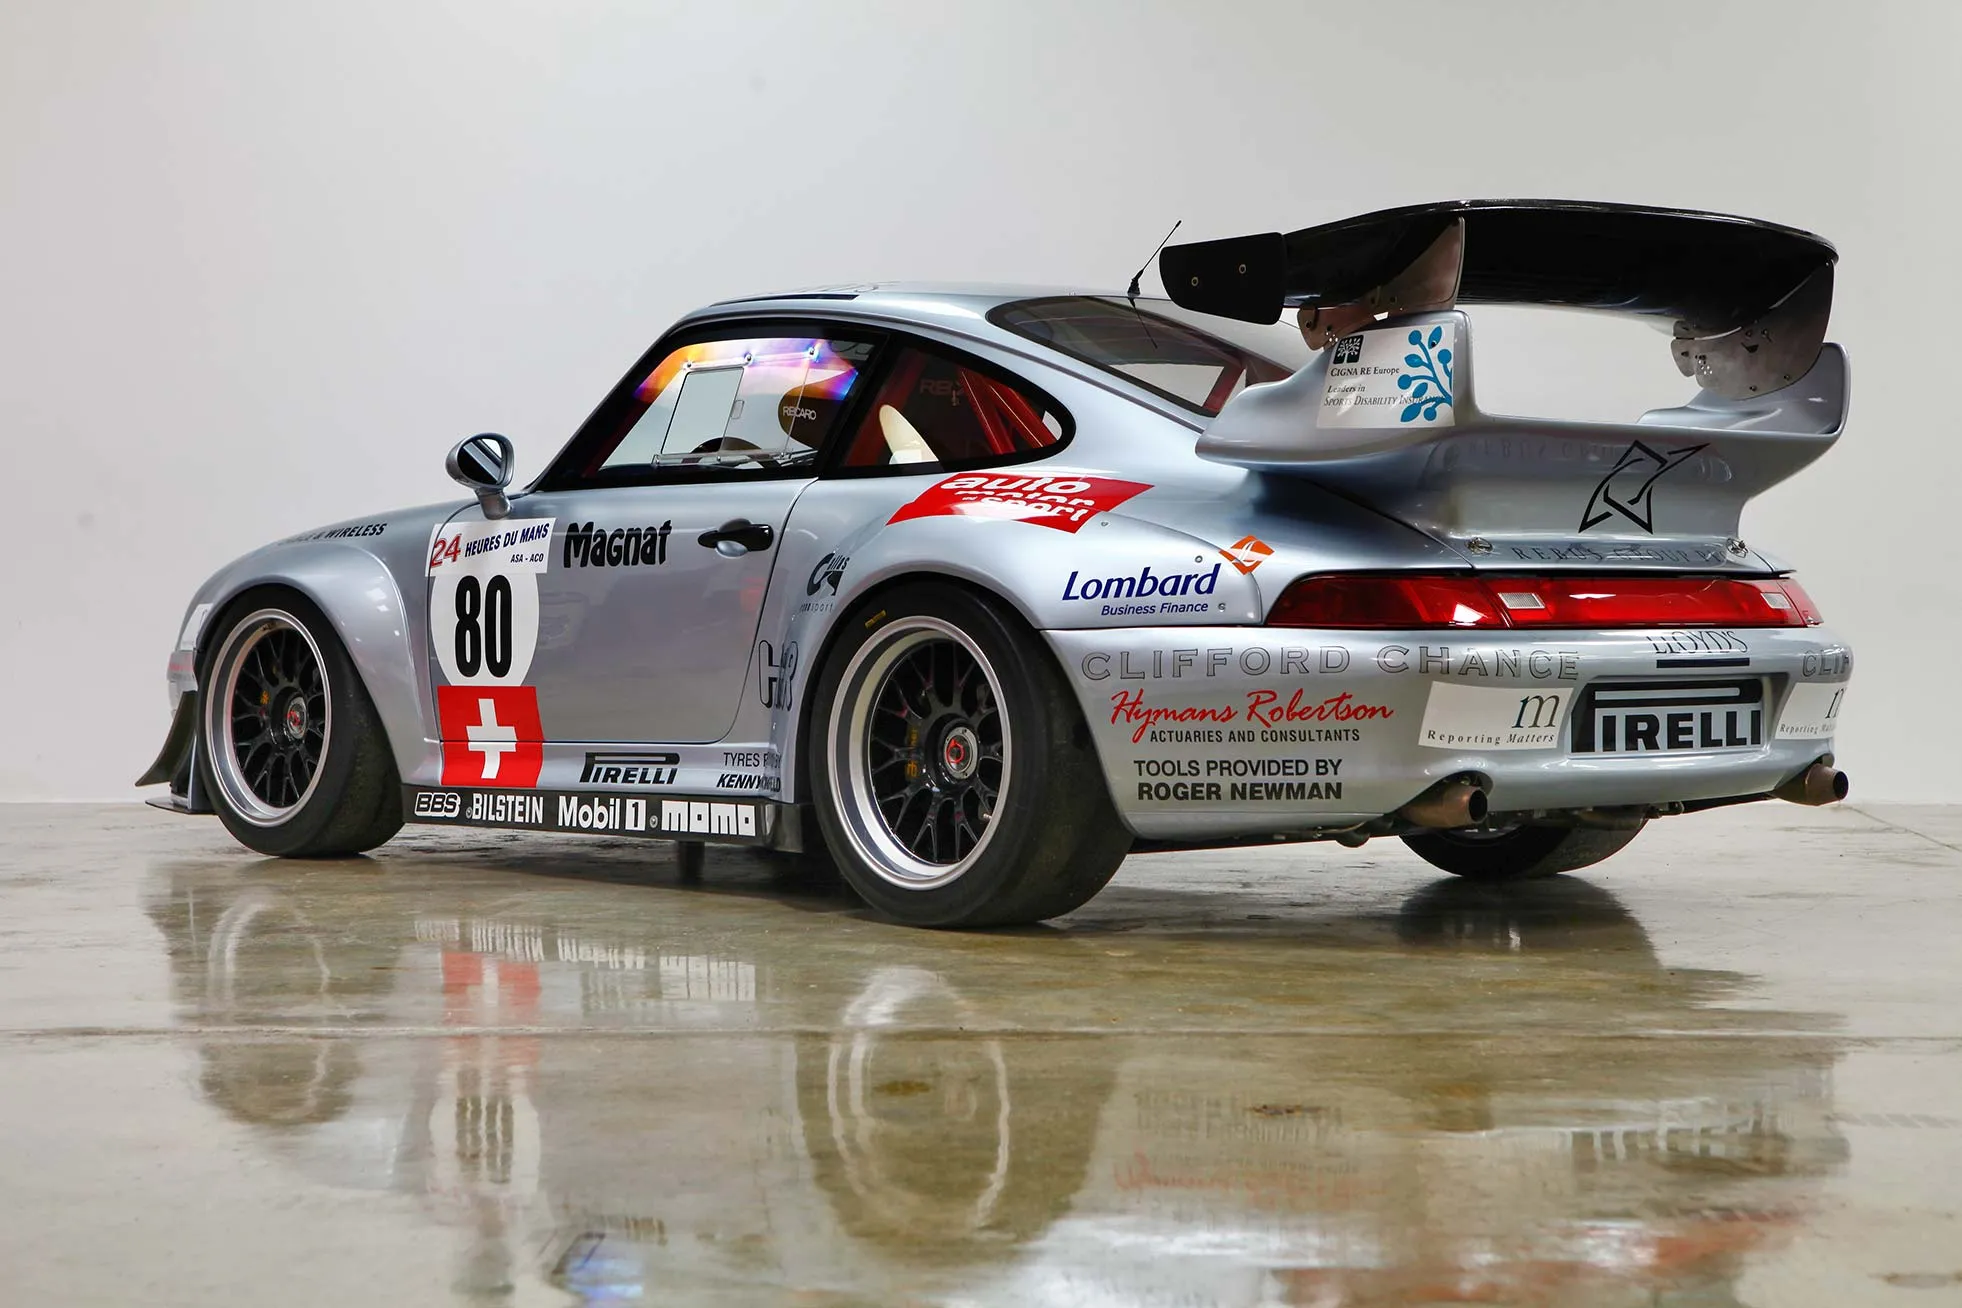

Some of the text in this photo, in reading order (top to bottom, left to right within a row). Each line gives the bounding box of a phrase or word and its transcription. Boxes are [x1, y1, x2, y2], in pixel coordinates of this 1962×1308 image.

[1330, 366, 1399, 377] CIGNA RE Europe
[1357, 383, 1366, 392] in
[782, 405, 817, 421] RECARO
[940, 476, 1092, 494] auto
[324, 522, 388, 539] WIRELESS
[431, 522, 550, 568] 24 HEURES DU MANS
[563, 519, 672, 568] Magnat
[510, 553, 524, 563] ASA
[529, 552, 545, 563] ACO
[1062, 563, 1222, 601] Lombard
[1101, 602, 1209, 616] Business Finance
[454, 574, 513, 678] 80
[1646, 630, 1749, 654] LLOYD'S
[1081, 644, 1580, 681] CLIFFORD CHANCE
[1110, 687, 1396, 744] Hymans Robertson
[1571, 678, 1764, 754] PIRELLI
[1150, 728, 1360, 743] ACTUARIES AND CONSULTANTS
[1427, 729, 1555, 746] Reporting Matters
[579, 752, 680, 785] PIRELLI
[723, 752, 760, 767] TYRES
[1133, 758, 1343, 777] TOOLS PROVIDED BY
[1138, 782, 1343, 801] ROGER NEWMAN
[414, 792, 461, 818] BBS
[471, 793, 544, 824] BILSTEIN
[558, 795, 647, 831] Mobil 1
[661, 800, 756, 837] momo
